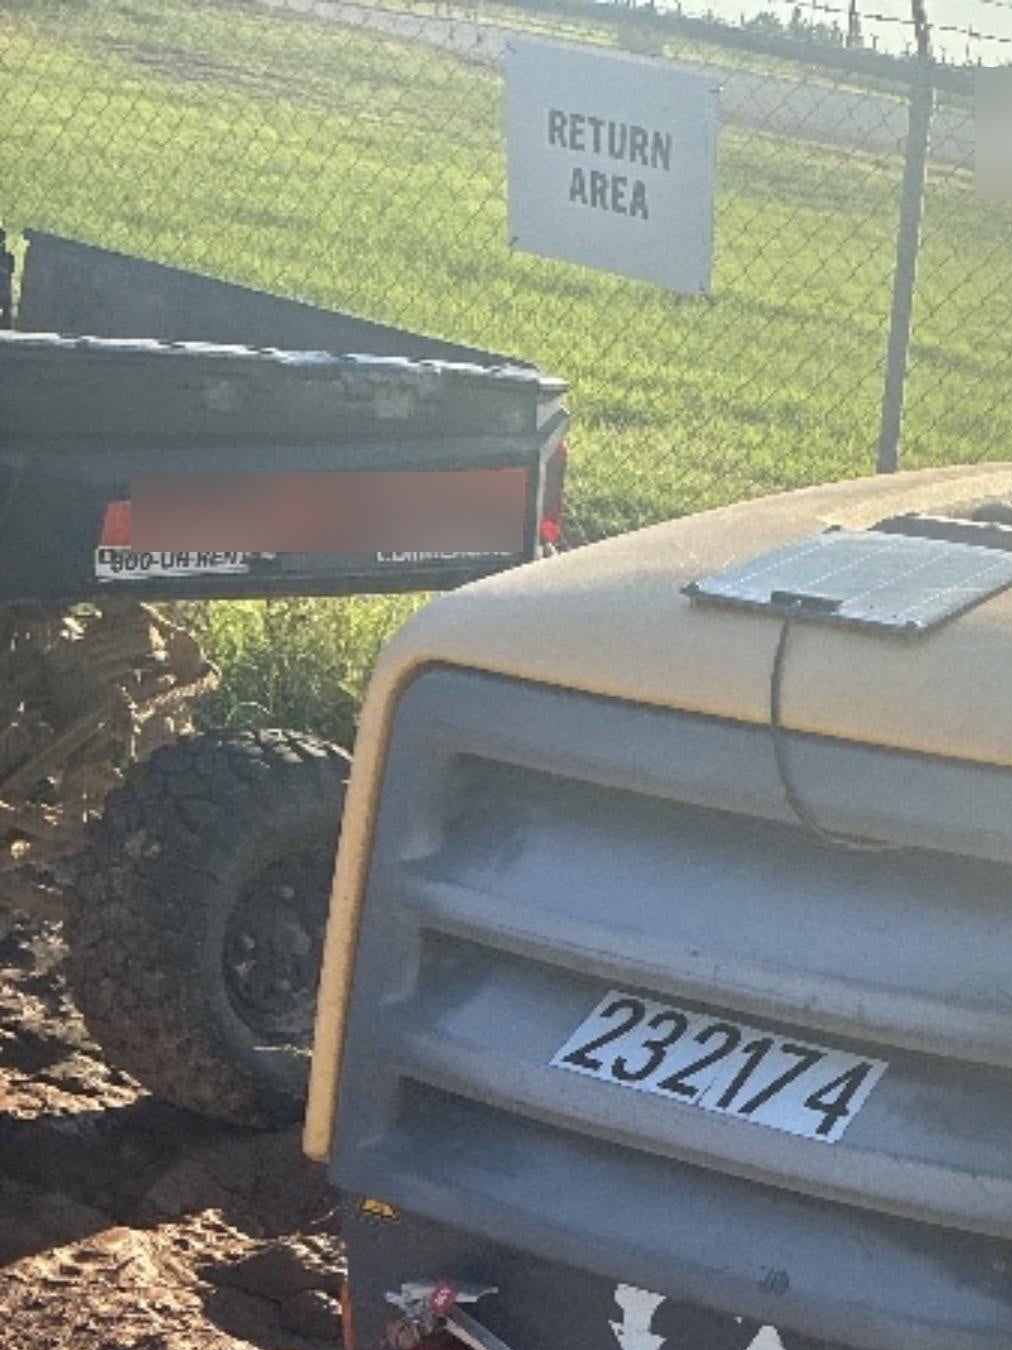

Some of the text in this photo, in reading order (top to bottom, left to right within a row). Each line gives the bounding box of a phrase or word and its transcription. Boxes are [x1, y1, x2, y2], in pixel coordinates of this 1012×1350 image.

[548, 108, 672, 171] RETURN
[569, 167, 649, 220] AREA
[561, 998, 874, 1136] 232174
